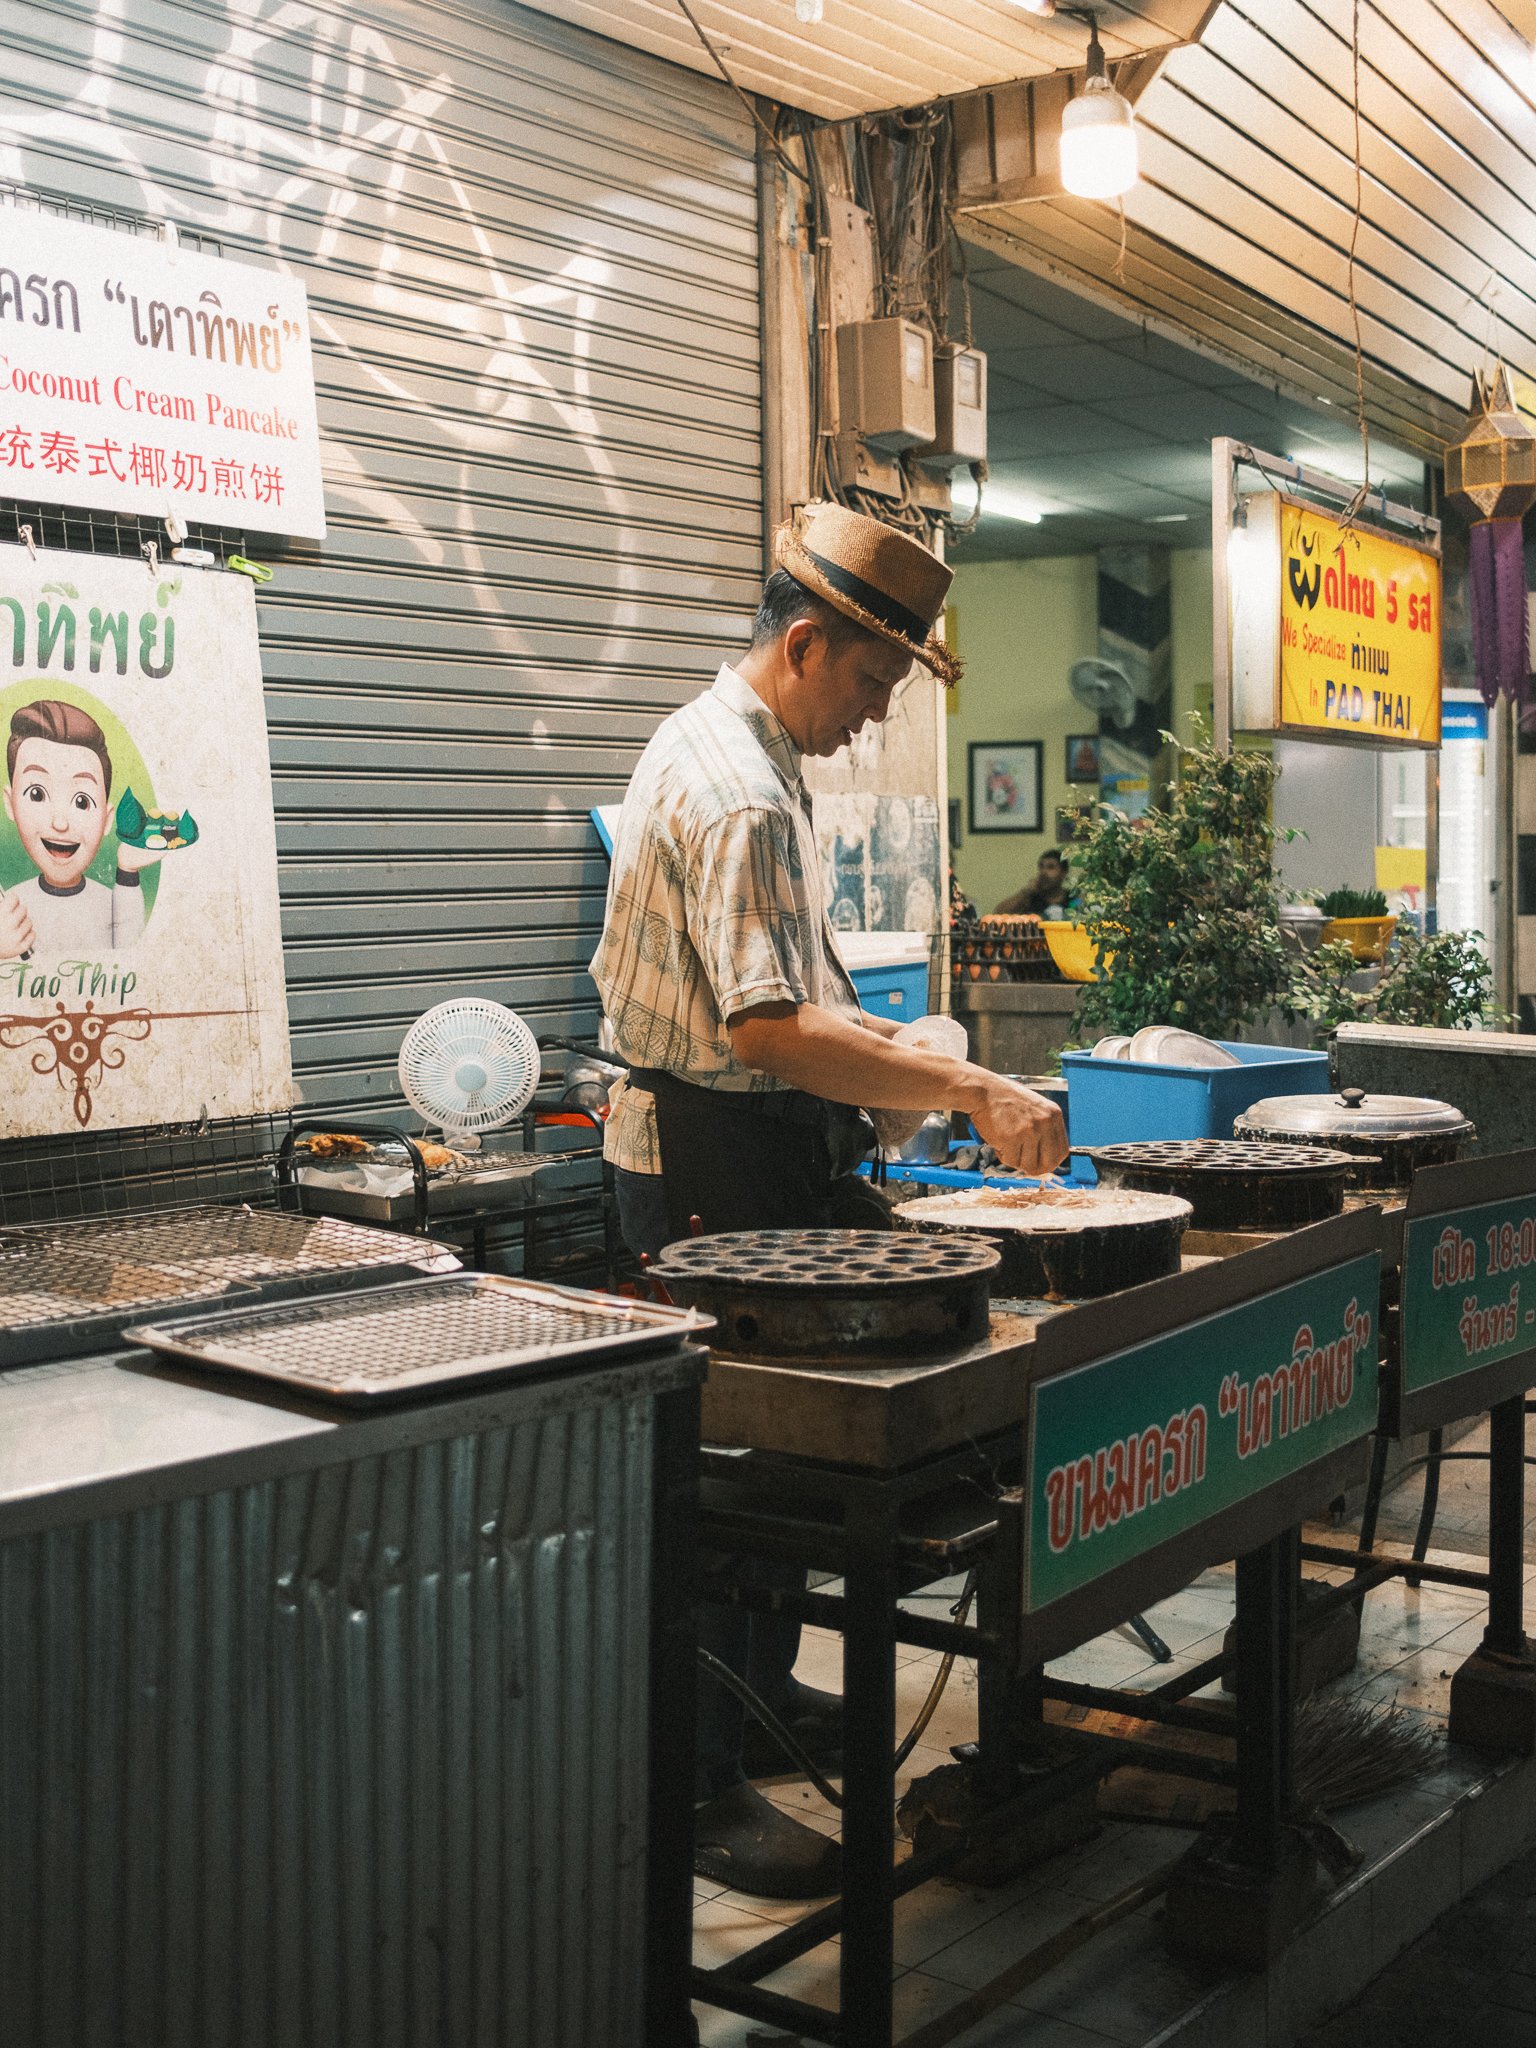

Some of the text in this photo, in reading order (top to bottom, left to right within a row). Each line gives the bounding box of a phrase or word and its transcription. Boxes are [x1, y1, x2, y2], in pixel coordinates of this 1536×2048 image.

[113, 376, 197, 422] Cream
[206, 392, 299, 441] Pancake
[1289, 529, 1432, 634] ผัดไทย 5 รส
[1281, 615, 1297, 649] We
[1325, 679, 1364, 722] PAD
[1373, 690, 1411, 731] THAI
[0, 960, 137, 1006] Tao Thip
[1432, 1217, 1536, 1290] เปิด 18:0
[1459, 1281, 1520, 1356] จันทร์
[1046, 1403, 1208, 1553] ขนมครก
